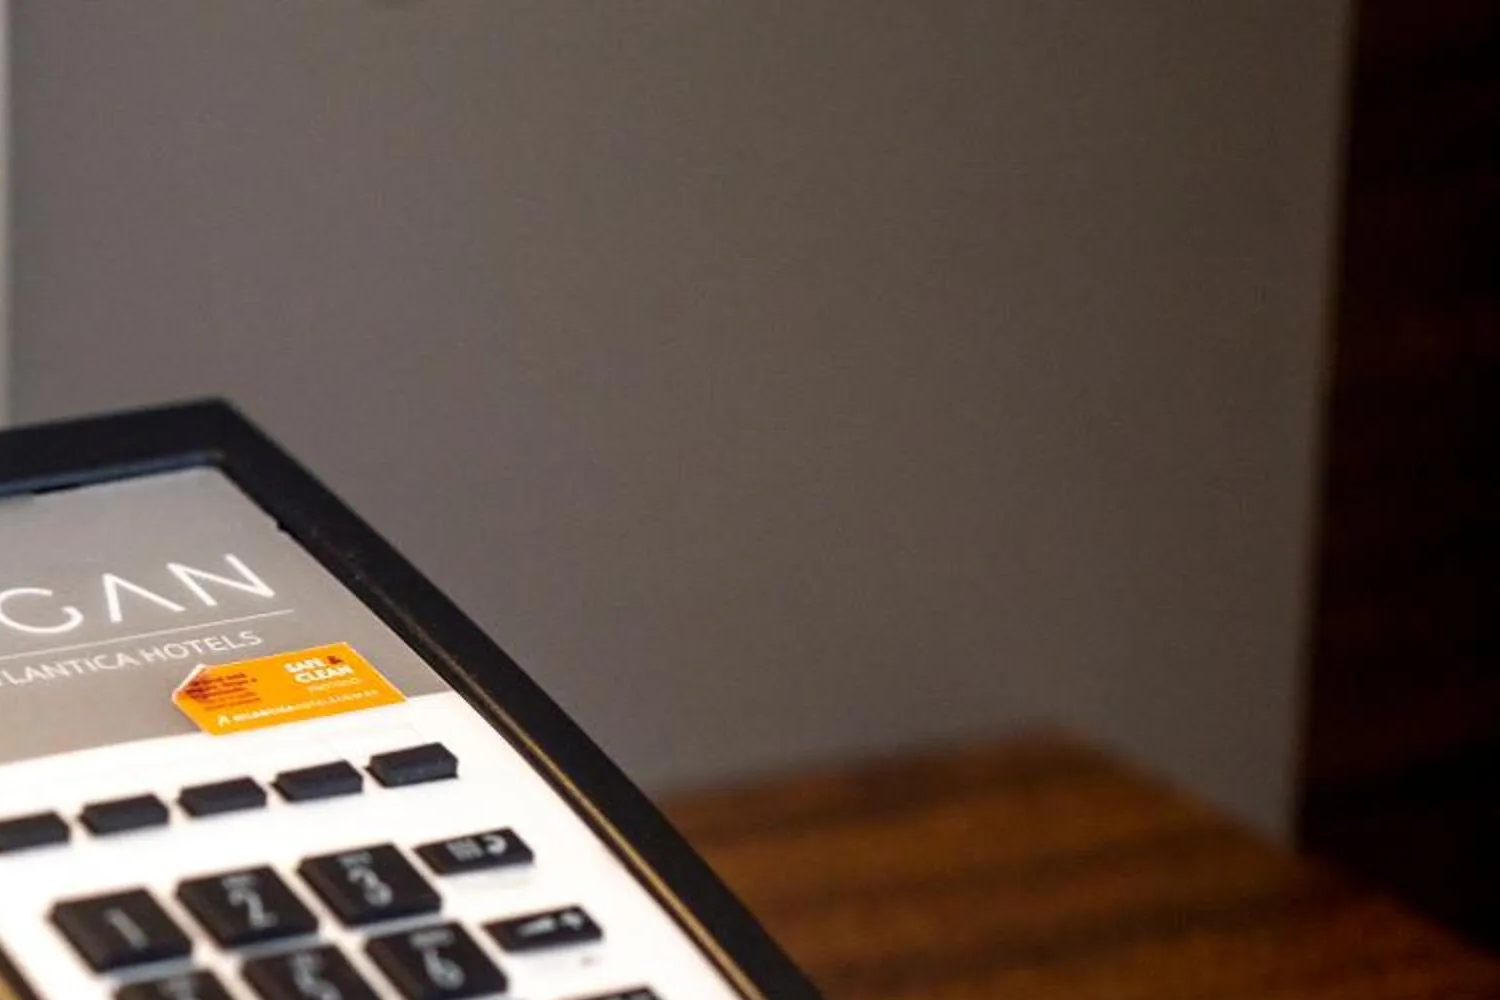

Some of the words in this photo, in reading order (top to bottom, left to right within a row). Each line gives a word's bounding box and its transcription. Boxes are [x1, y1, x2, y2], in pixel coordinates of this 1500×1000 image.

[142, 630, 264, 664] HOTELS
[283, 657, 325, 673] SAFE
[294, 665, 355, 684] CLEAN
[346, 866, 394, 907] 3
[227, 887, 278, 929] 2
[105, 908, 150, 951] 1
[422, 946, 466, 990] 6
